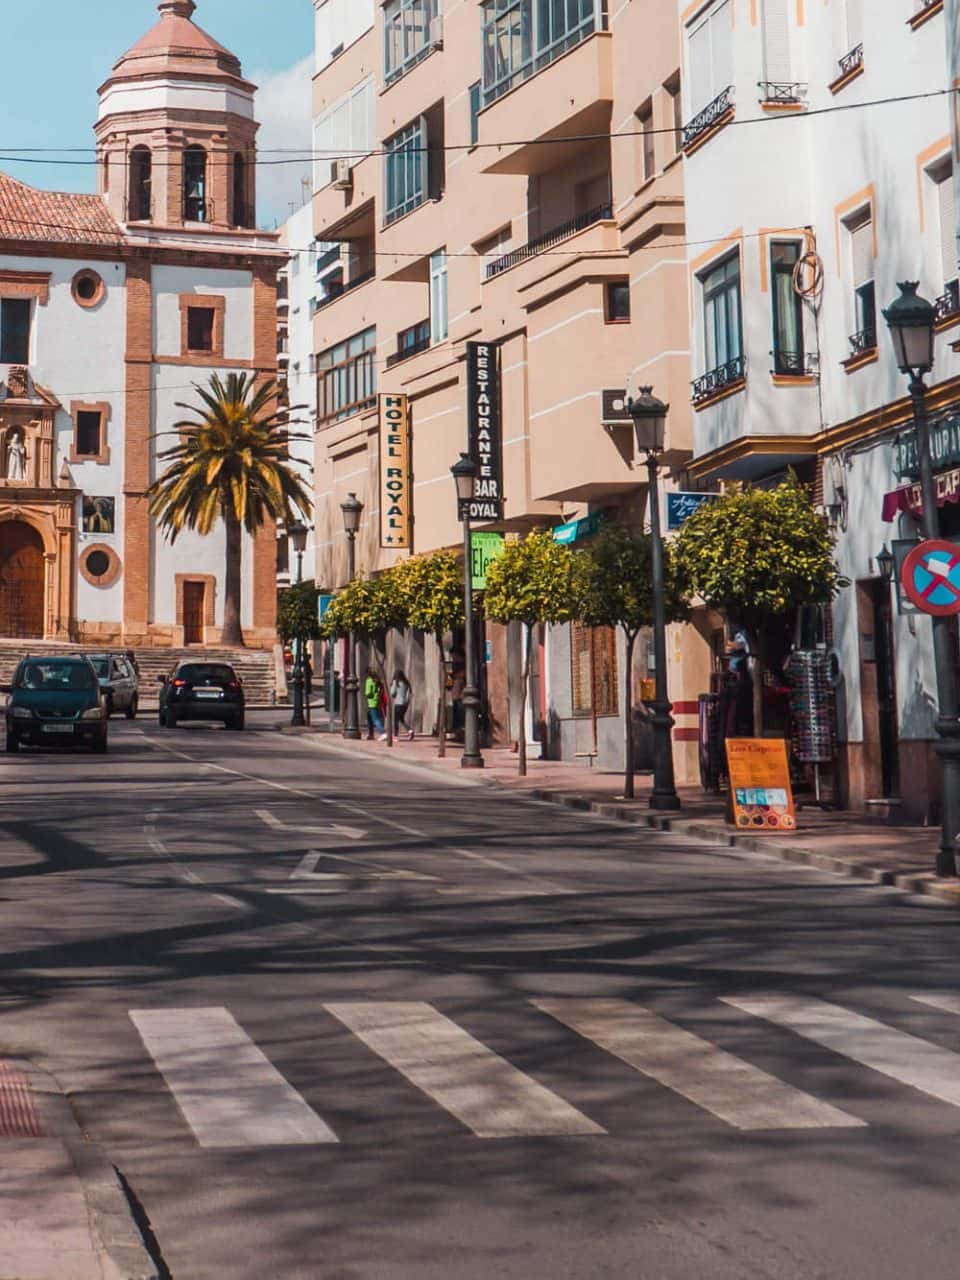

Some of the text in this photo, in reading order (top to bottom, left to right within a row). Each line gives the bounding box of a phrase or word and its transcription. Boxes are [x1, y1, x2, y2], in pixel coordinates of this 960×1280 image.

[476, 345, 491, 477] RESTAURANTE
[385, 397, 403, 528] HOTEL ROYAL
[474, 479, 497, 497] BAR
[468, 503, 498, 517] OYAL
[472, 548, 496, 577] Ele
